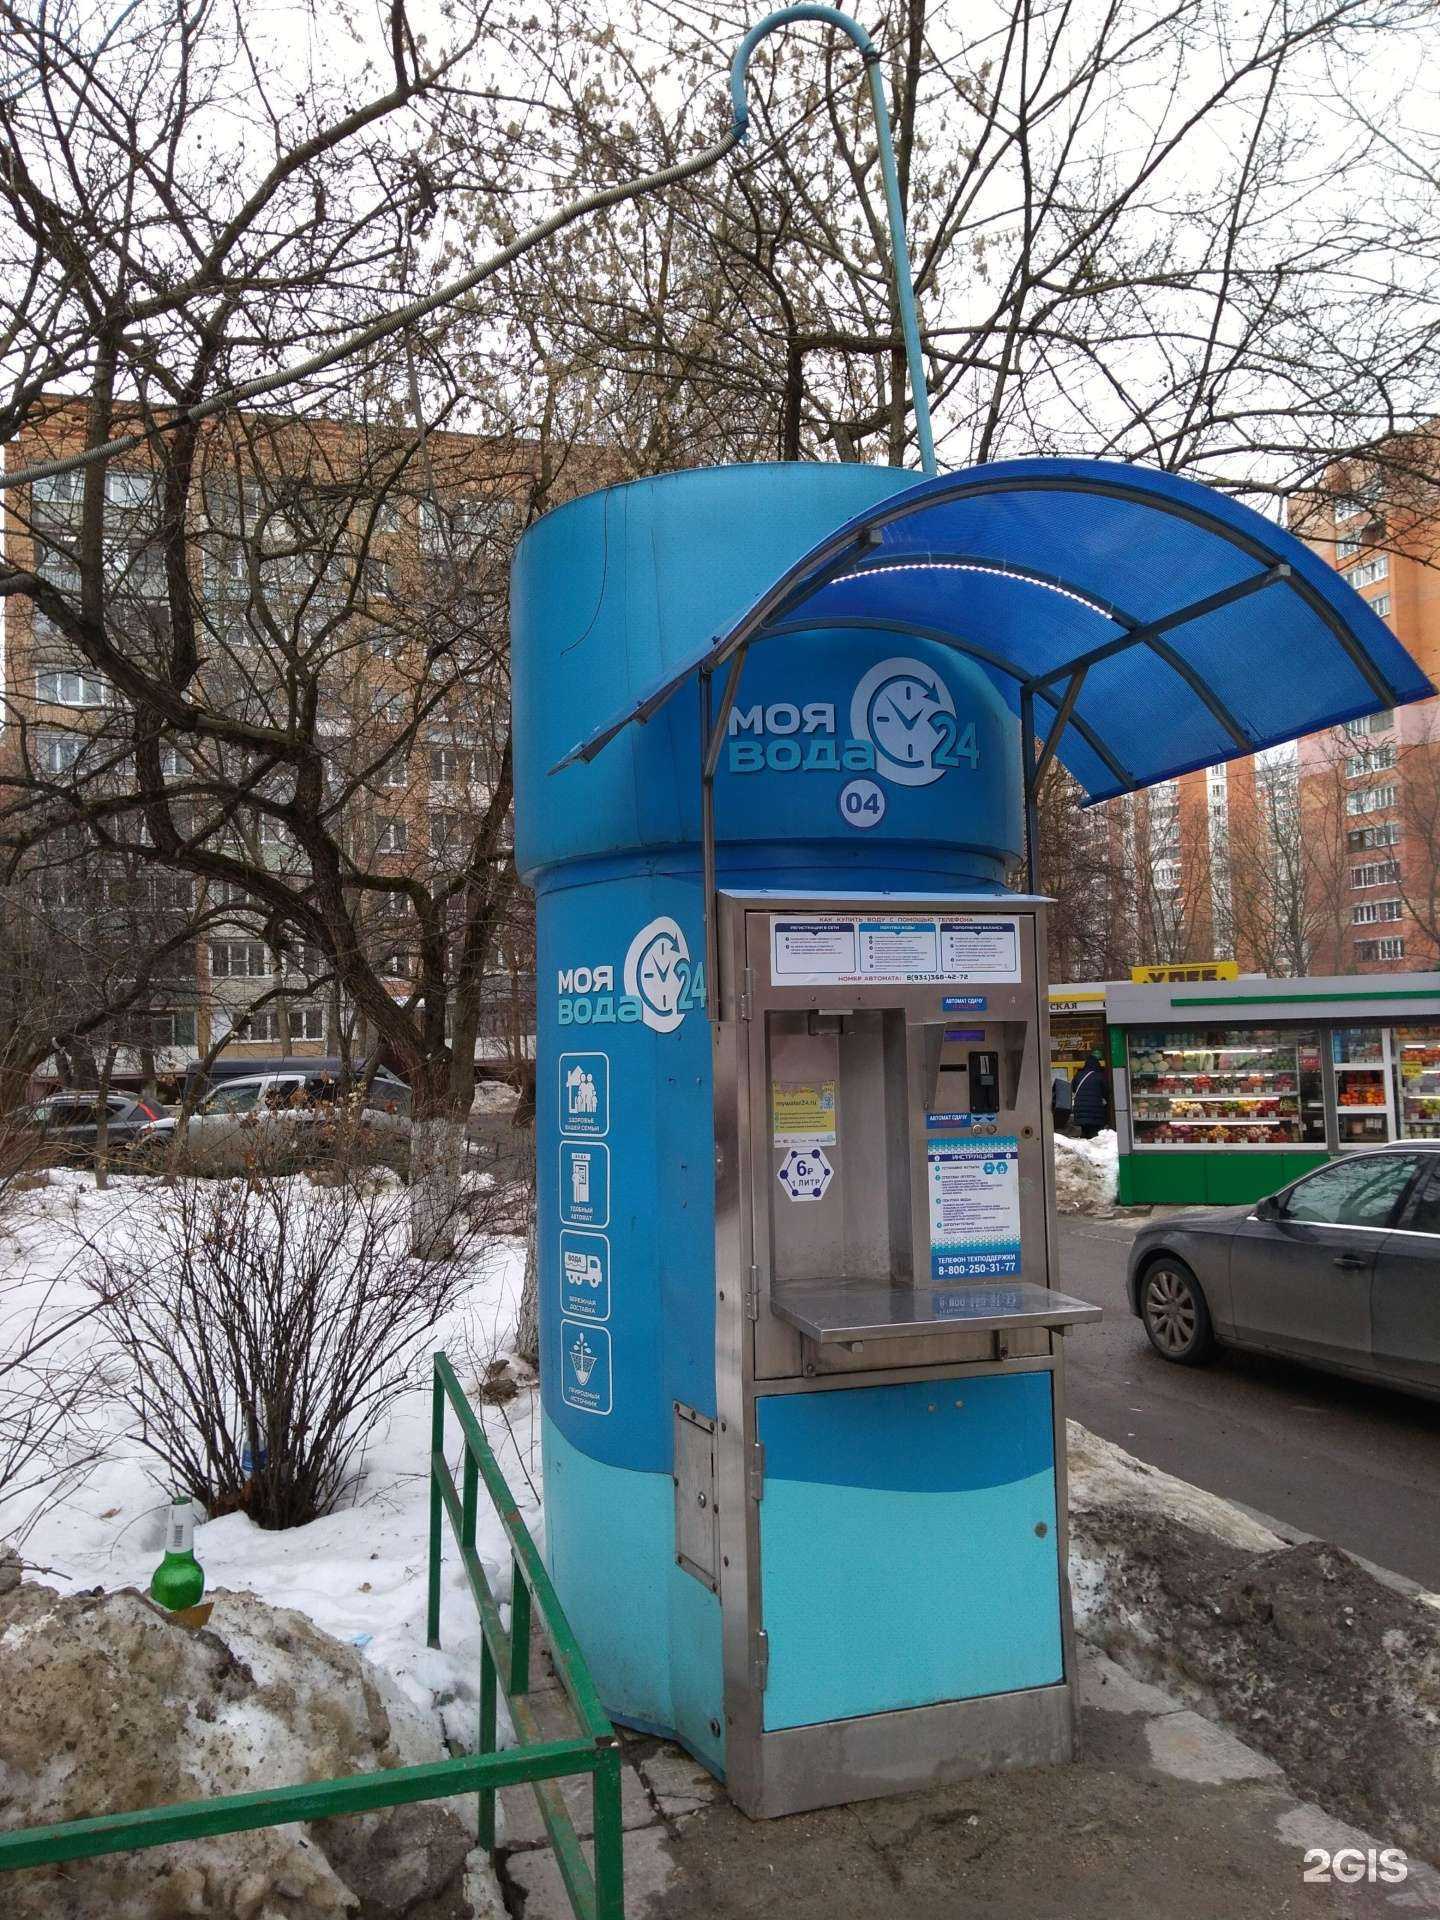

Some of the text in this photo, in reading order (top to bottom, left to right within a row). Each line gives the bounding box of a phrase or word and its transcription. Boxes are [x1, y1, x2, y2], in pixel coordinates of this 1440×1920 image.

[729, 702, 835, 736] МОЯ
[931, 711, 980, 770] 24
[845, 793, 880, 814] 04
[558, 966, 614, 995] МОЯ
[674, 958, 707, 1010] 24
[952, 1153, 994, 1161] ИНСТРУКЦИЯ
[798, 1178, 821, 1187] ЛИТР
[568, 1254, 582, 1263] ВОДА
[938, 1254, 1015, 1264] ТЕЛЕФОН ТЕХПОДДЕРЖКИ
[938, 1263, 1016, 1275] 8-800-250-31-77
